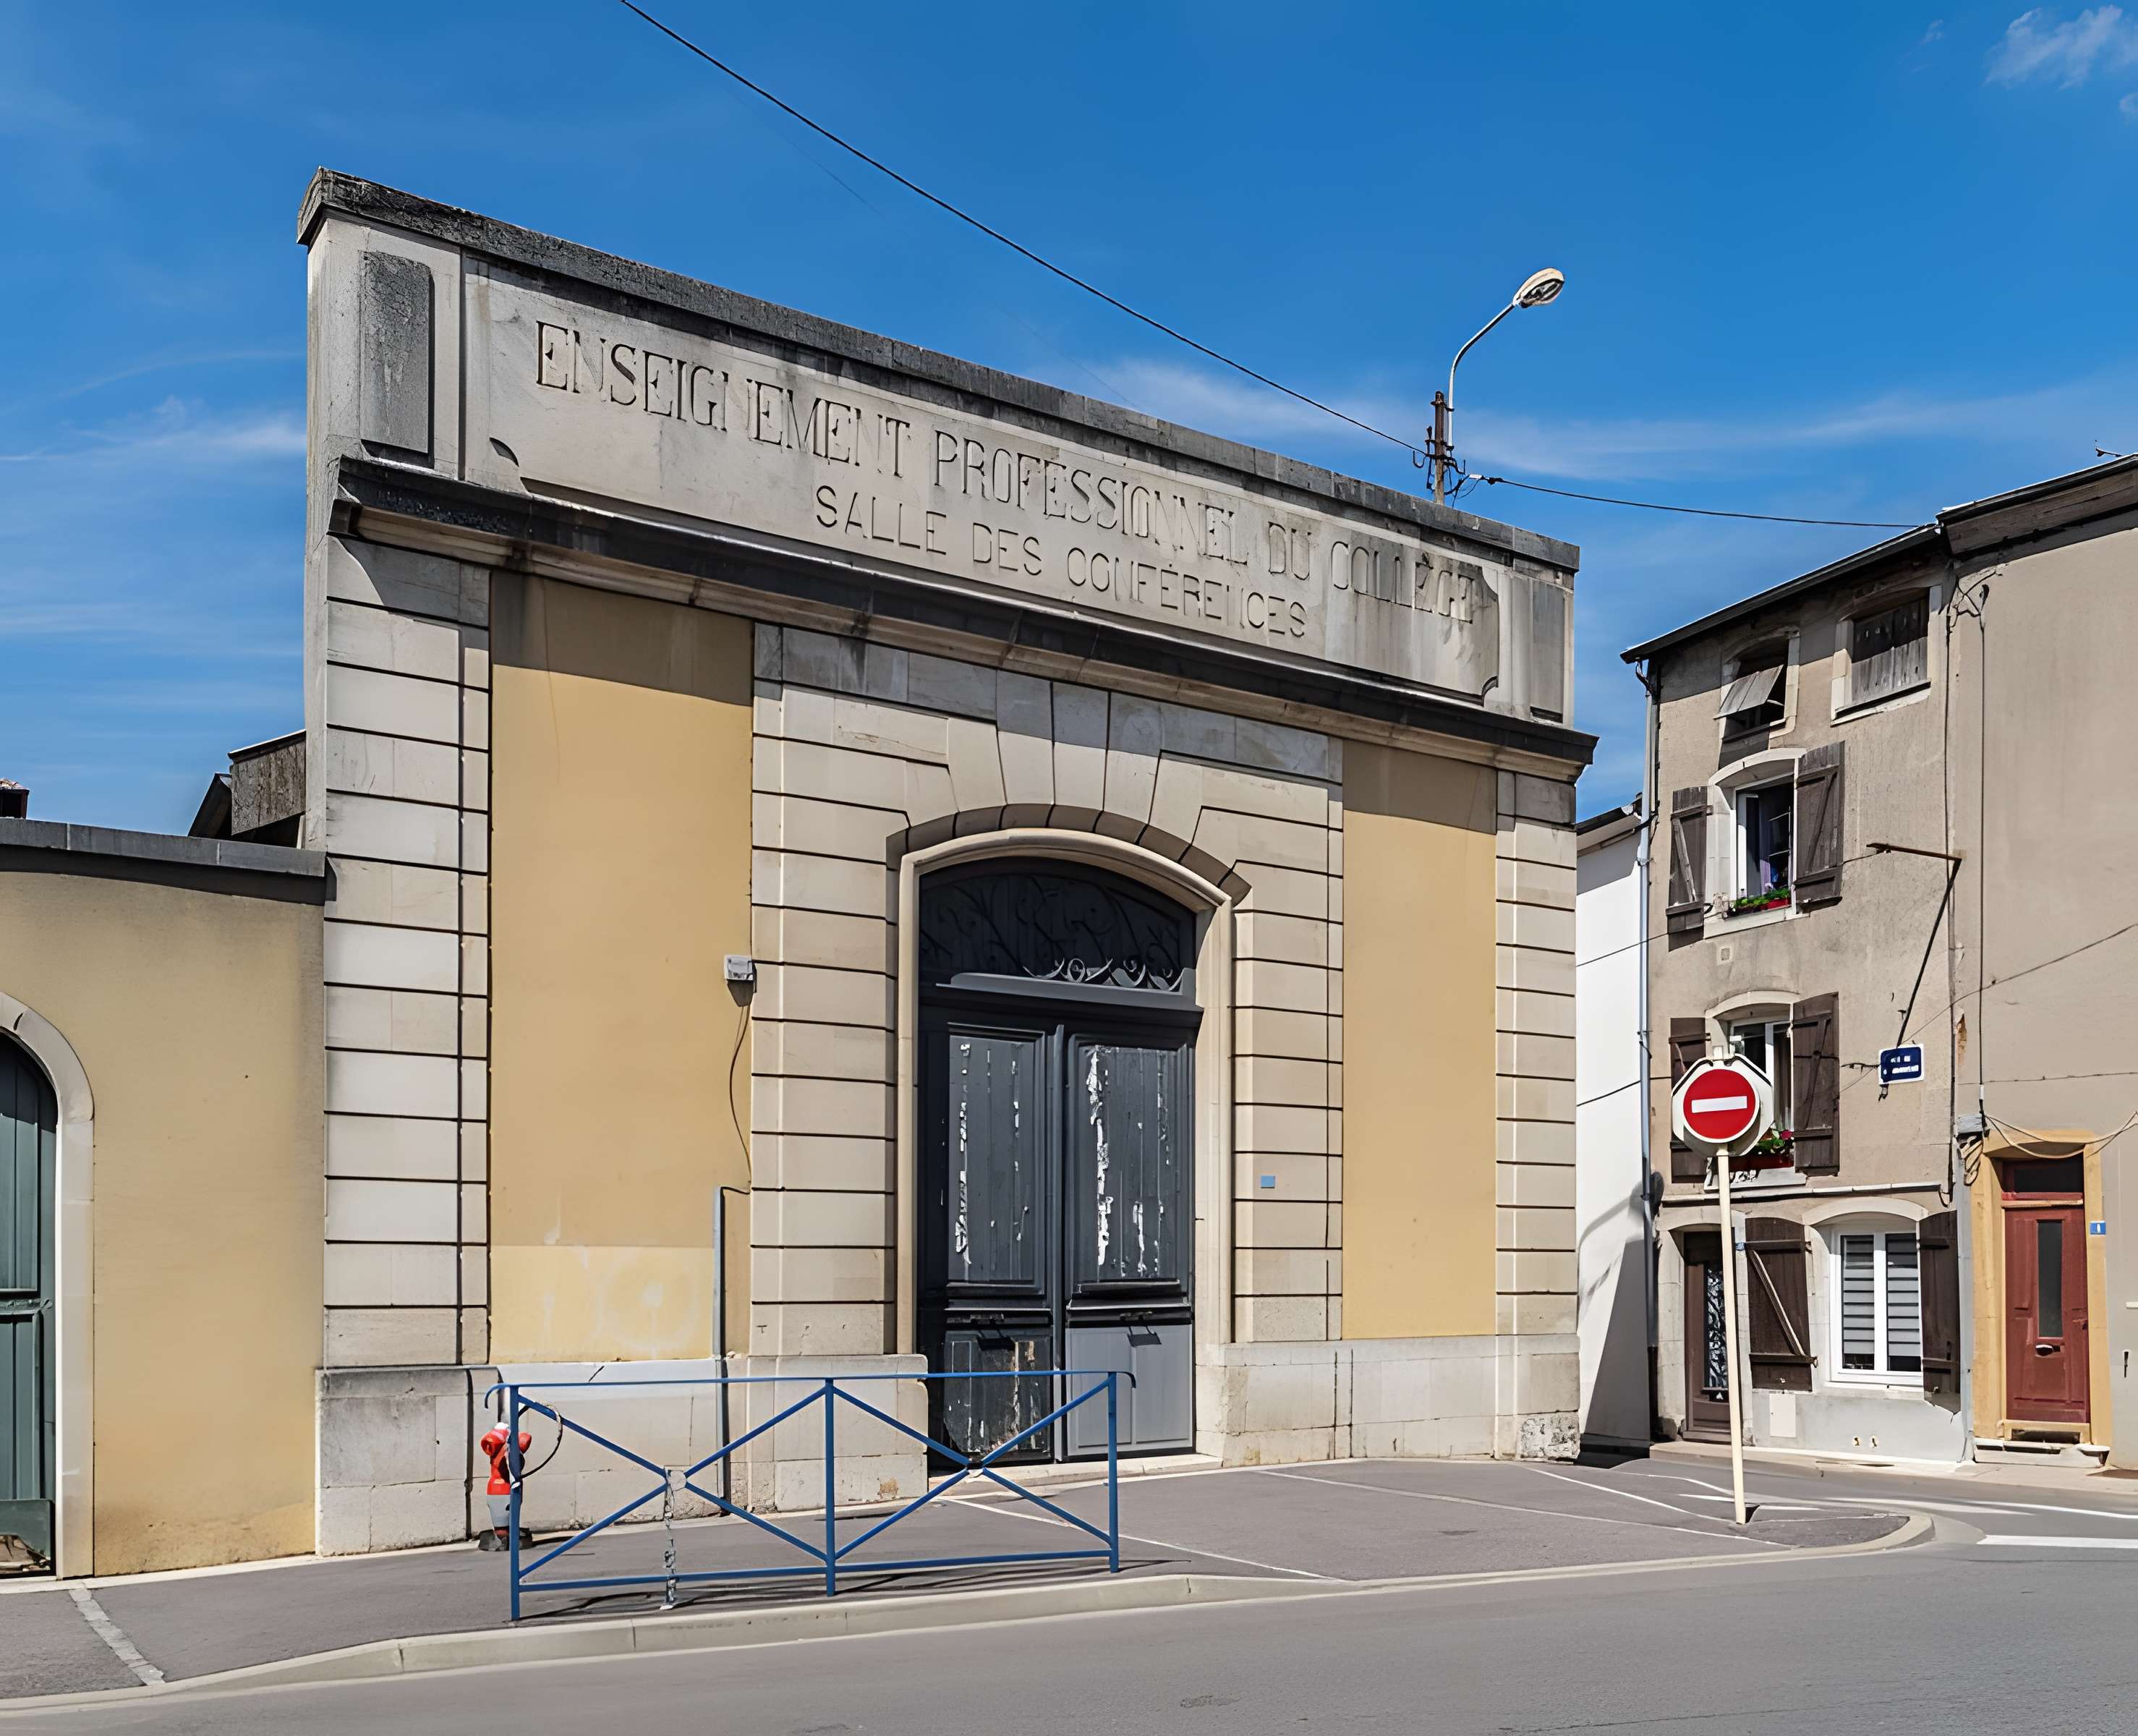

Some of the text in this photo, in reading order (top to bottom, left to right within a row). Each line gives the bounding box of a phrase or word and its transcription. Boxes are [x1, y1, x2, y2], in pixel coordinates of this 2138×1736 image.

[536, 320, 911, 477] ENSEIGNEMENT
[935, 430, 1249, 566] PROFESSIONNEL
[1268, 521, 1311, 581] DU
[816, 485, 947, 555] SALLE
[973, 522, 1042, 576] DES
